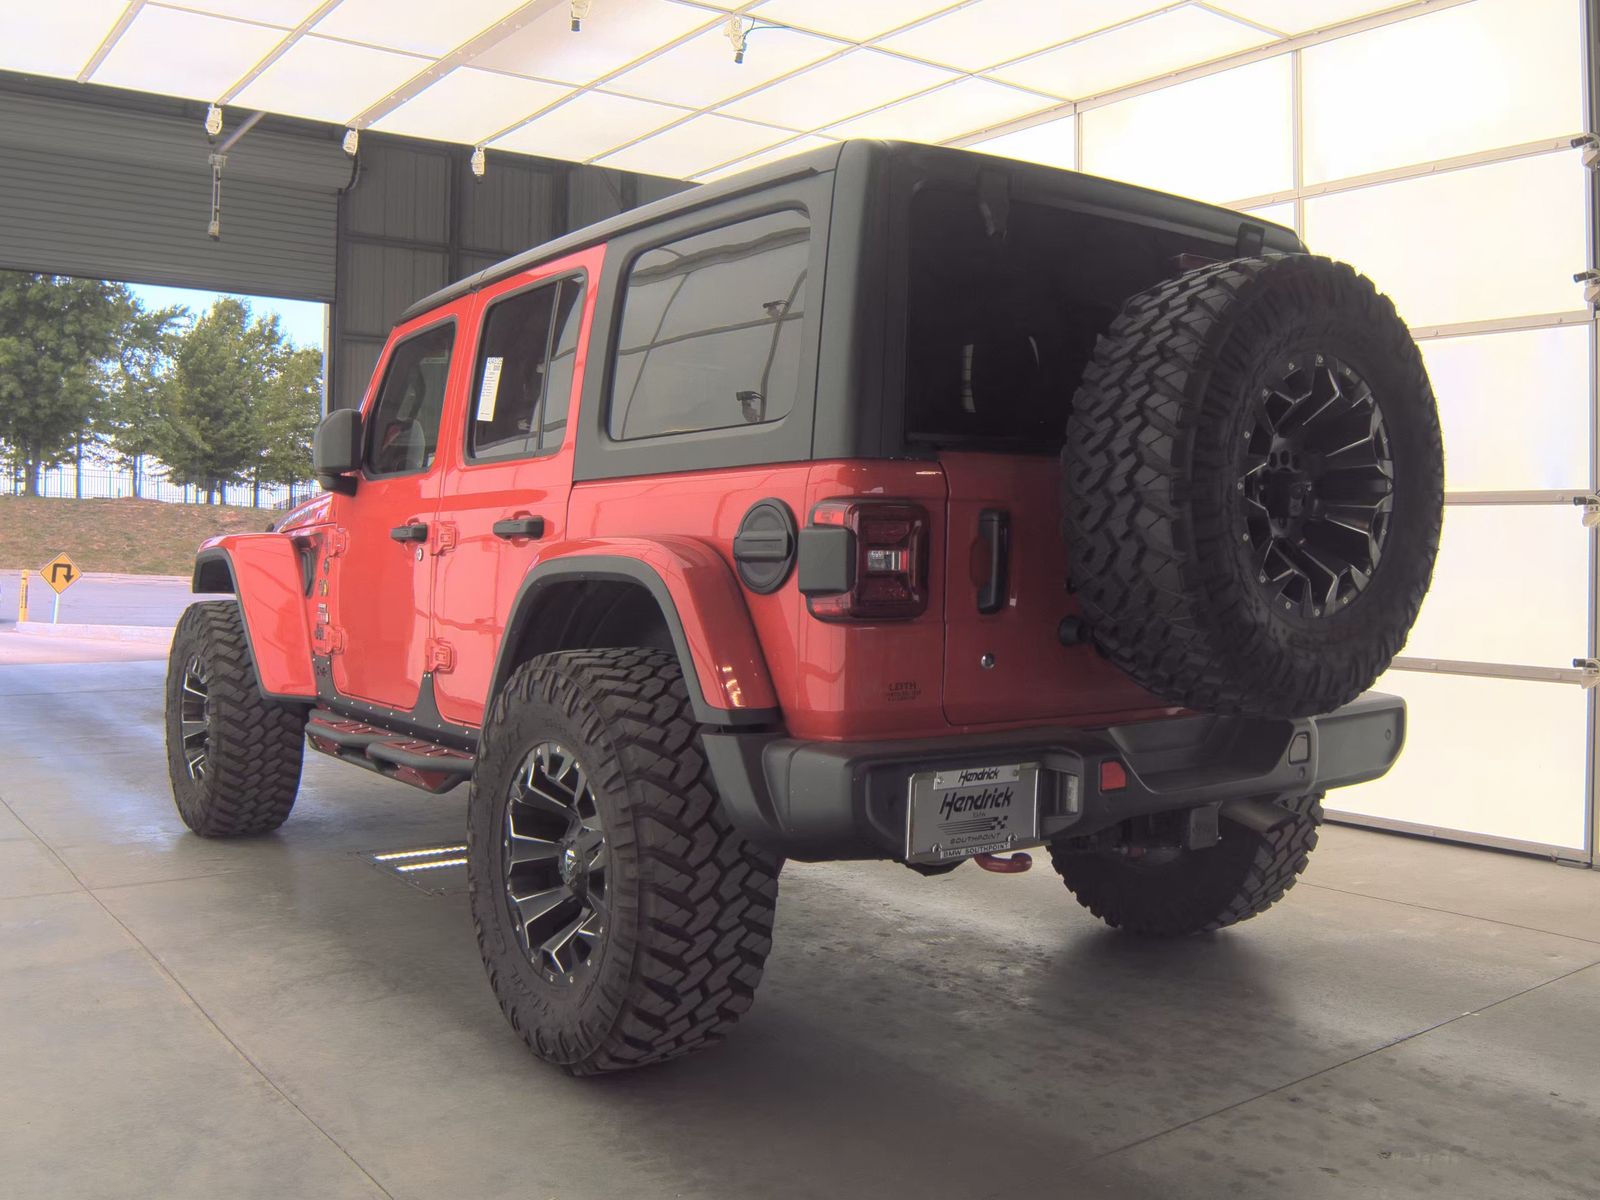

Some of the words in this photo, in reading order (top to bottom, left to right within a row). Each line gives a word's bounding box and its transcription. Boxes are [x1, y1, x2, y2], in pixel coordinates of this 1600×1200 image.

[957, 768, 1000, 786] Hendrick
[939, 787, 1014, 821] Hendrick
[950, 833, 1001, 844] SOUTHPOINT
[943, 849, 962, 858] BMW
[966, 843, 1009, 854] SOUTHPOINT
